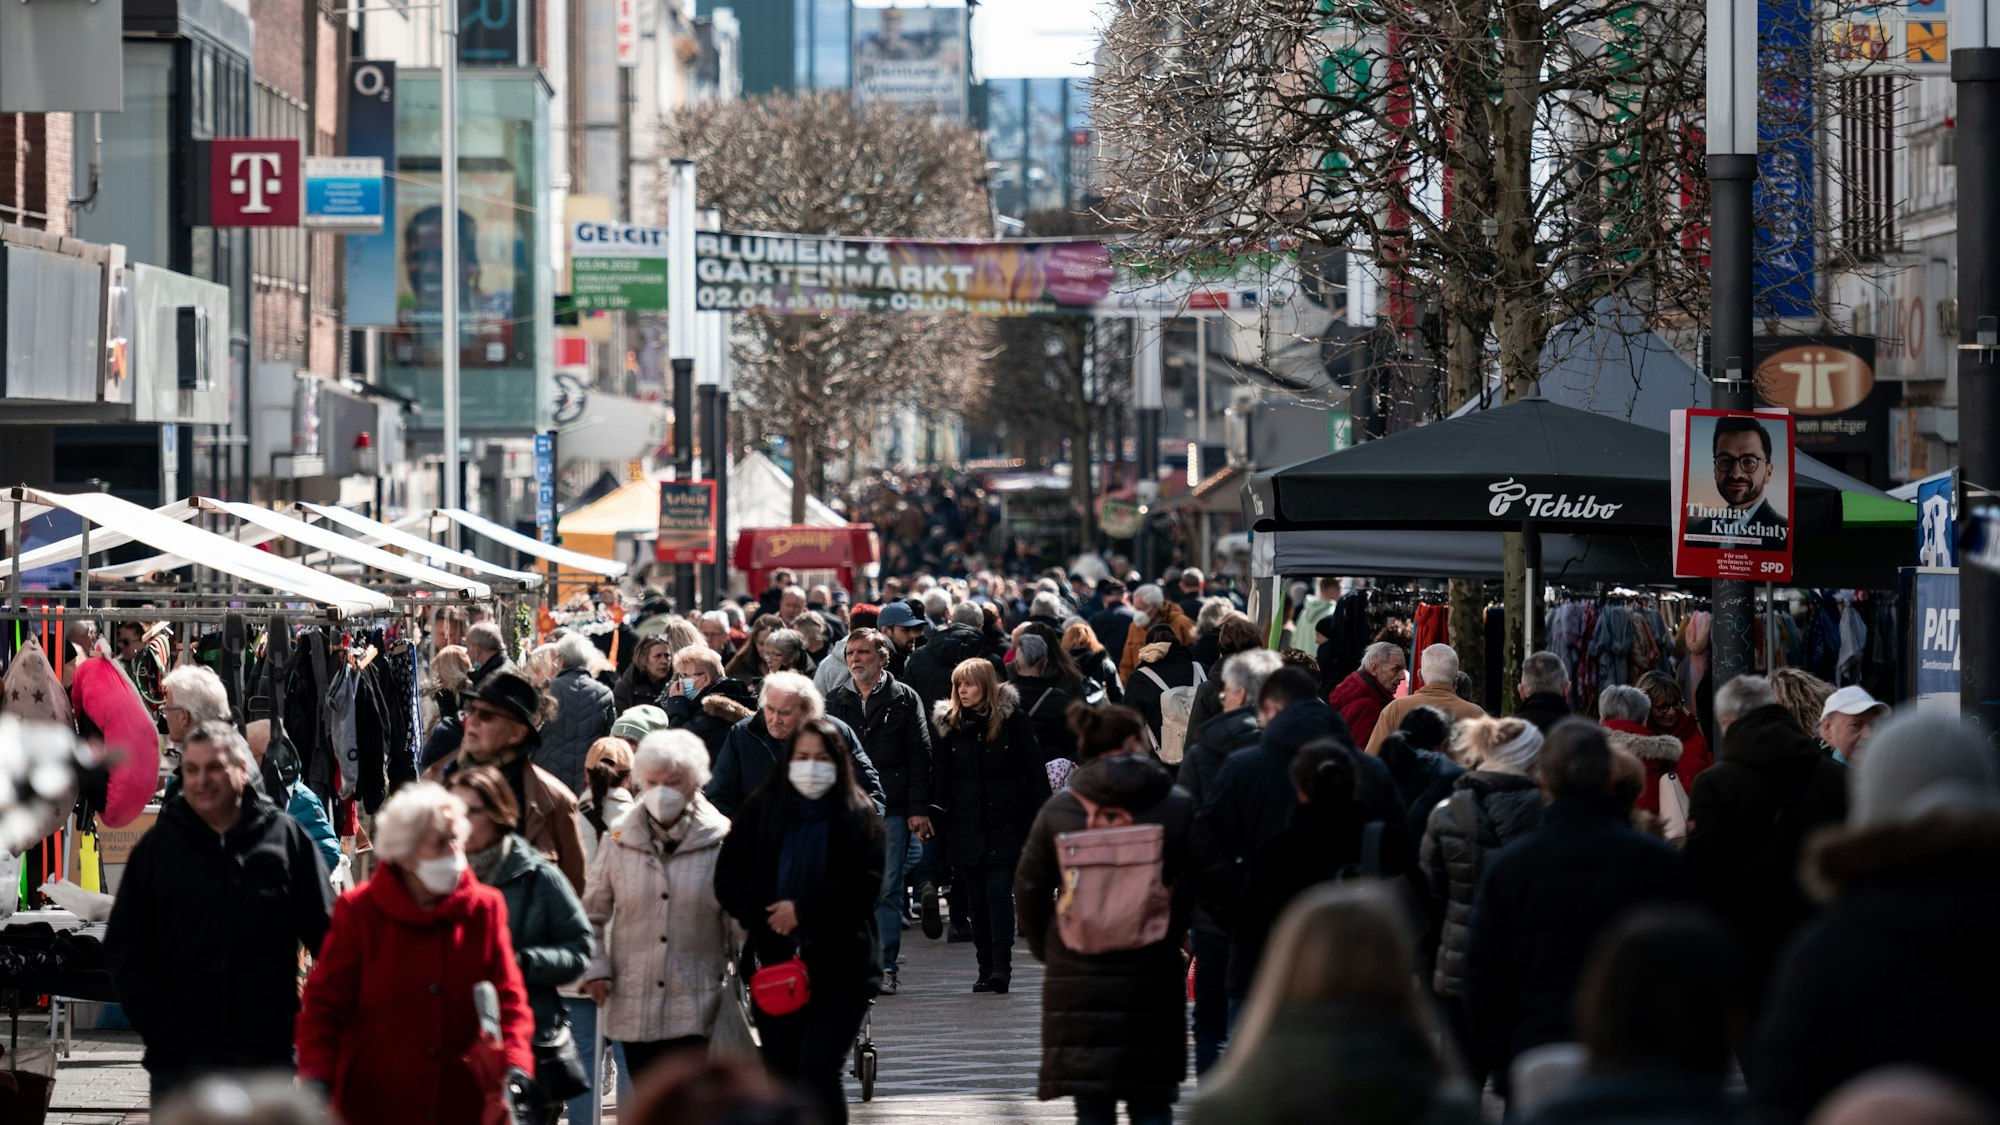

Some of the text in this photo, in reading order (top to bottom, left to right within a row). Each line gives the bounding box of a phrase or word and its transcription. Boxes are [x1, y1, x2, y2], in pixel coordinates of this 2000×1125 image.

[697, 235, 891, 263] BLUMEN- &
[697, 258, 974, 293] GARTENMARKT
[697, 288, 780, 308] 02.04.
[889, 291, 971, 311] 03.04.
[1821, 418, 1867, 436] metzger
[1525, 493, 1623, 519] Tchibo
[1686, 502, 1750, 520] Thomas
[1710, 519, 1789, 541] Kutschaty
[1760, 561, 1784, 574] SPD
